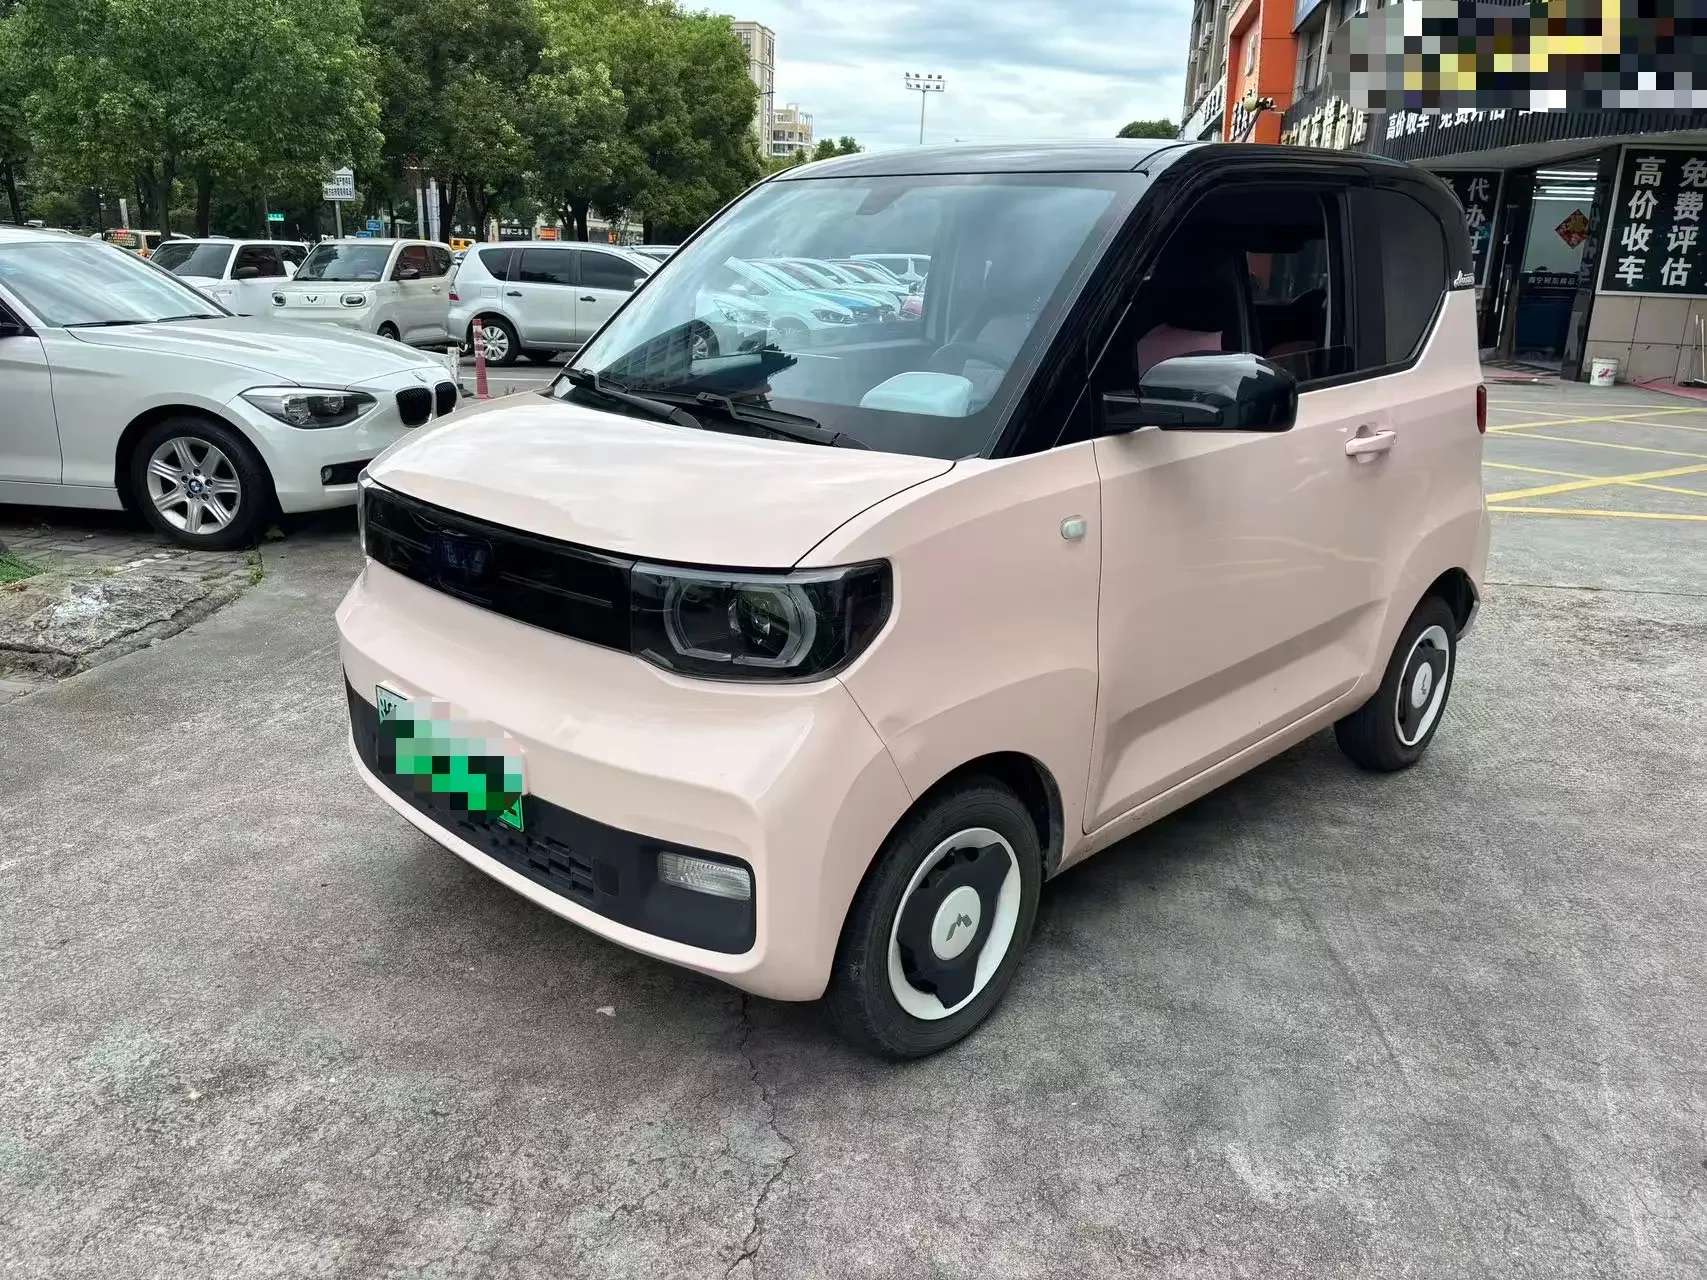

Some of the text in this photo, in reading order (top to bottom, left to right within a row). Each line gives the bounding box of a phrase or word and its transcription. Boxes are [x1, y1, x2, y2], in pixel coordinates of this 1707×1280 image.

[1386, 109, 1430, 141] 高价收车
[1466, 177, 1490, 271] 代办过
[1615, 156, 1666, 287] 高价收车
[1660, 157, 1707, 287] 免费评估
